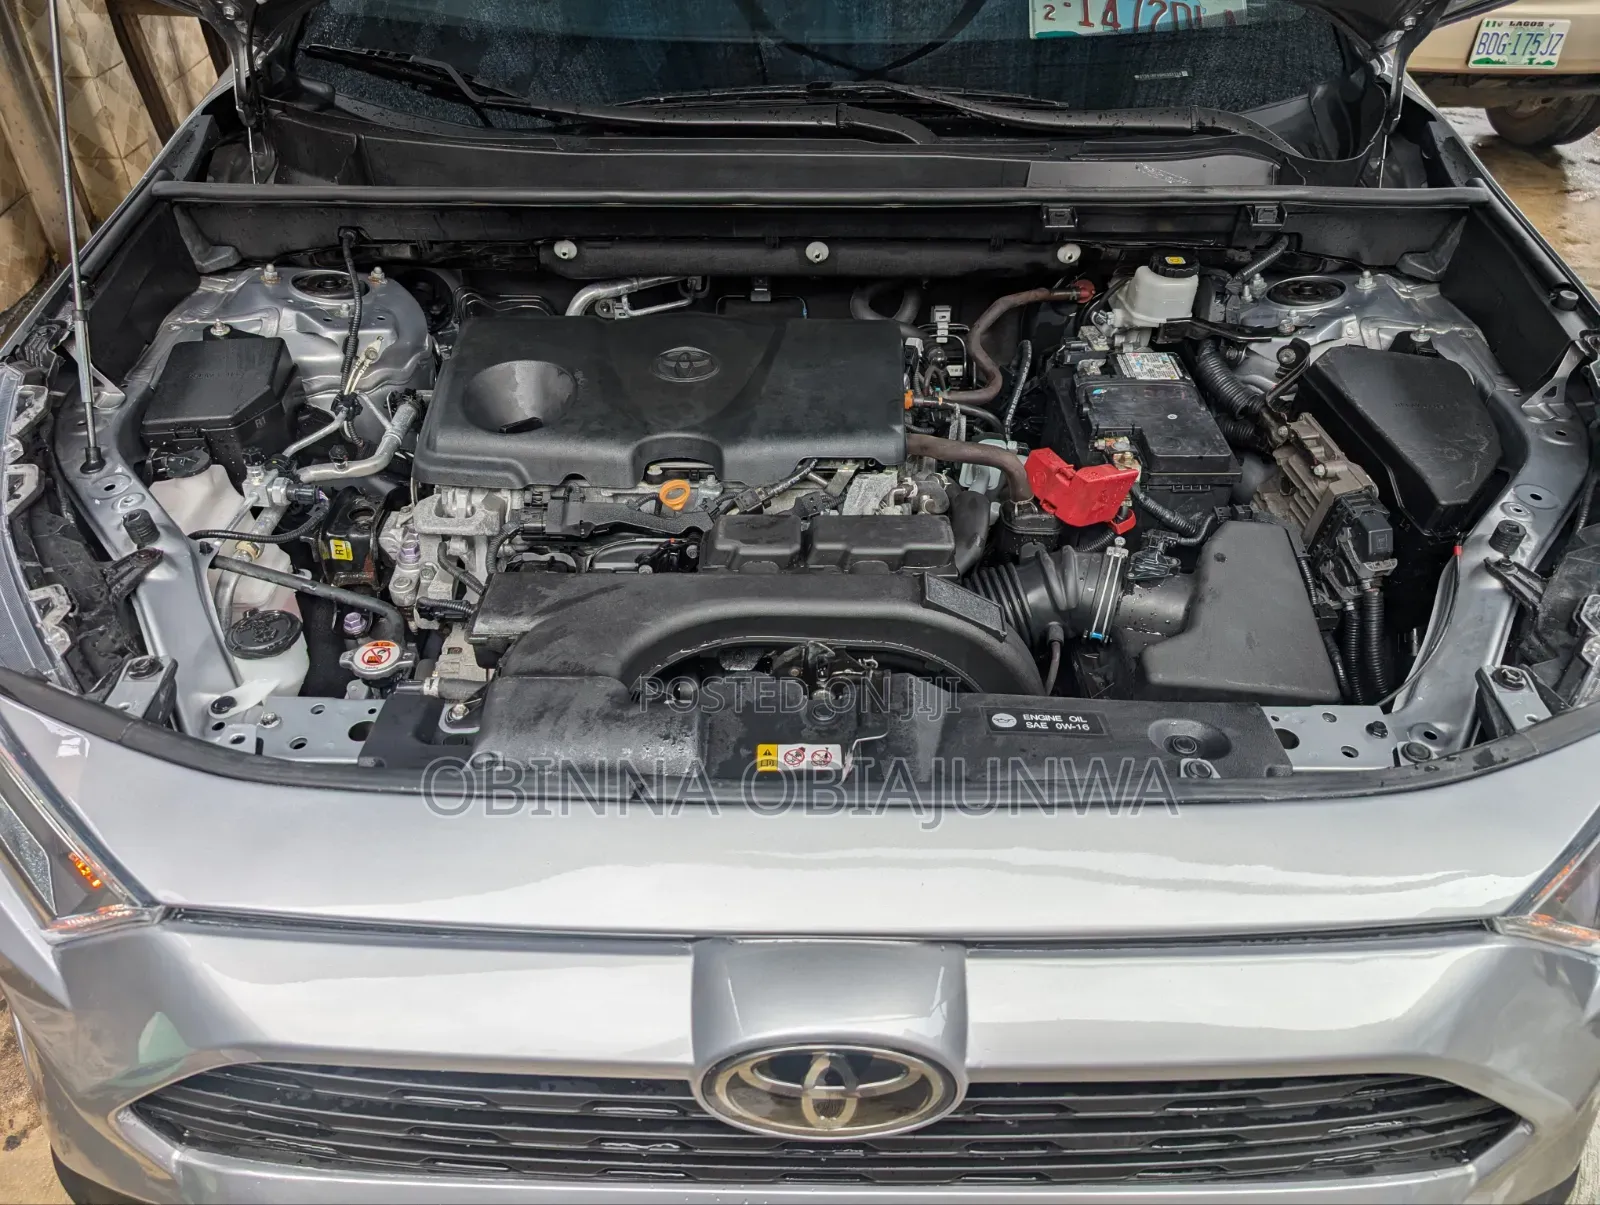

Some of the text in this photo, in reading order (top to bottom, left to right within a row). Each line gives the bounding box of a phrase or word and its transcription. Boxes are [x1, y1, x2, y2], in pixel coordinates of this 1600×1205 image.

[1475, 31, 1565, 57] BDG-175JZ
[1022, 713, 1088, 723] ENGINE OIL
[1025, 721, 1090, 731] SAE 0W-16
